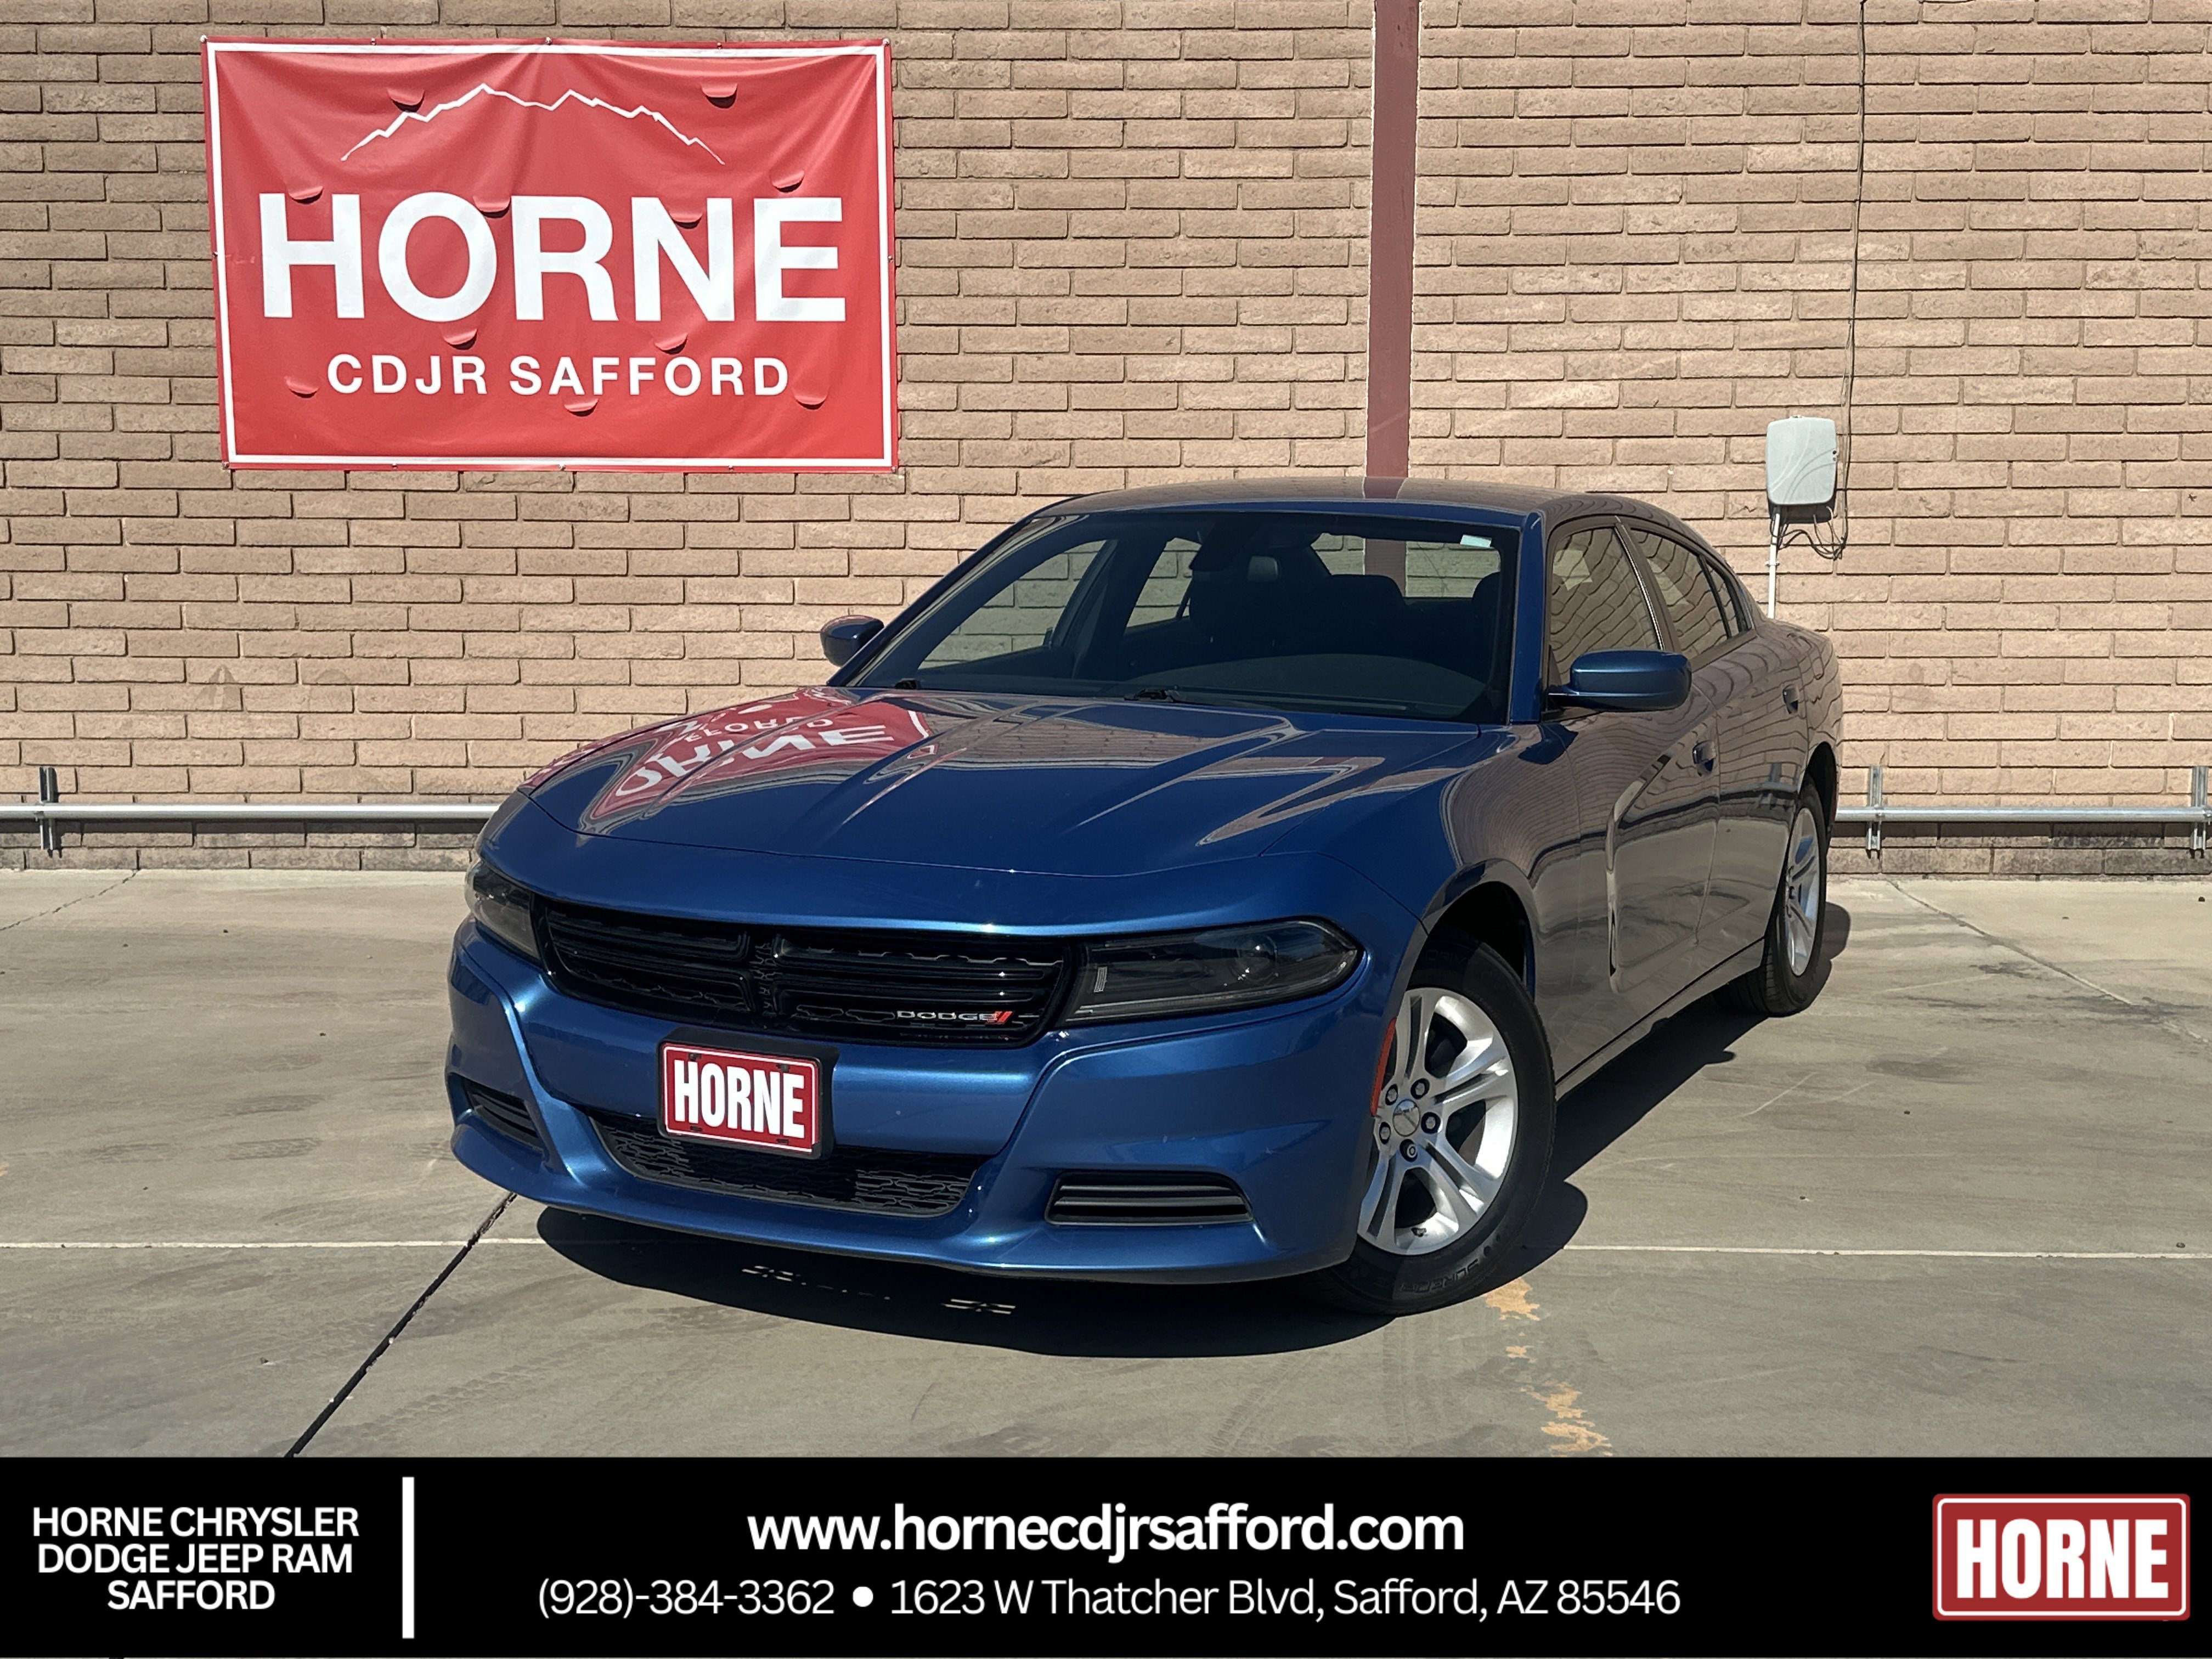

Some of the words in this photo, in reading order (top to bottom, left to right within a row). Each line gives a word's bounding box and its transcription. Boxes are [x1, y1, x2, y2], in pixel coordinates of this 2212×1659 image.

[259, 191, 846, 322] HORNE
[328, 354, 487, 394] CDJR
[510, 356, 788, 396] SAFFORD
[896, 1010, 998, 1021] DODGE
[674, 1059, 805, 1138] HORNE
